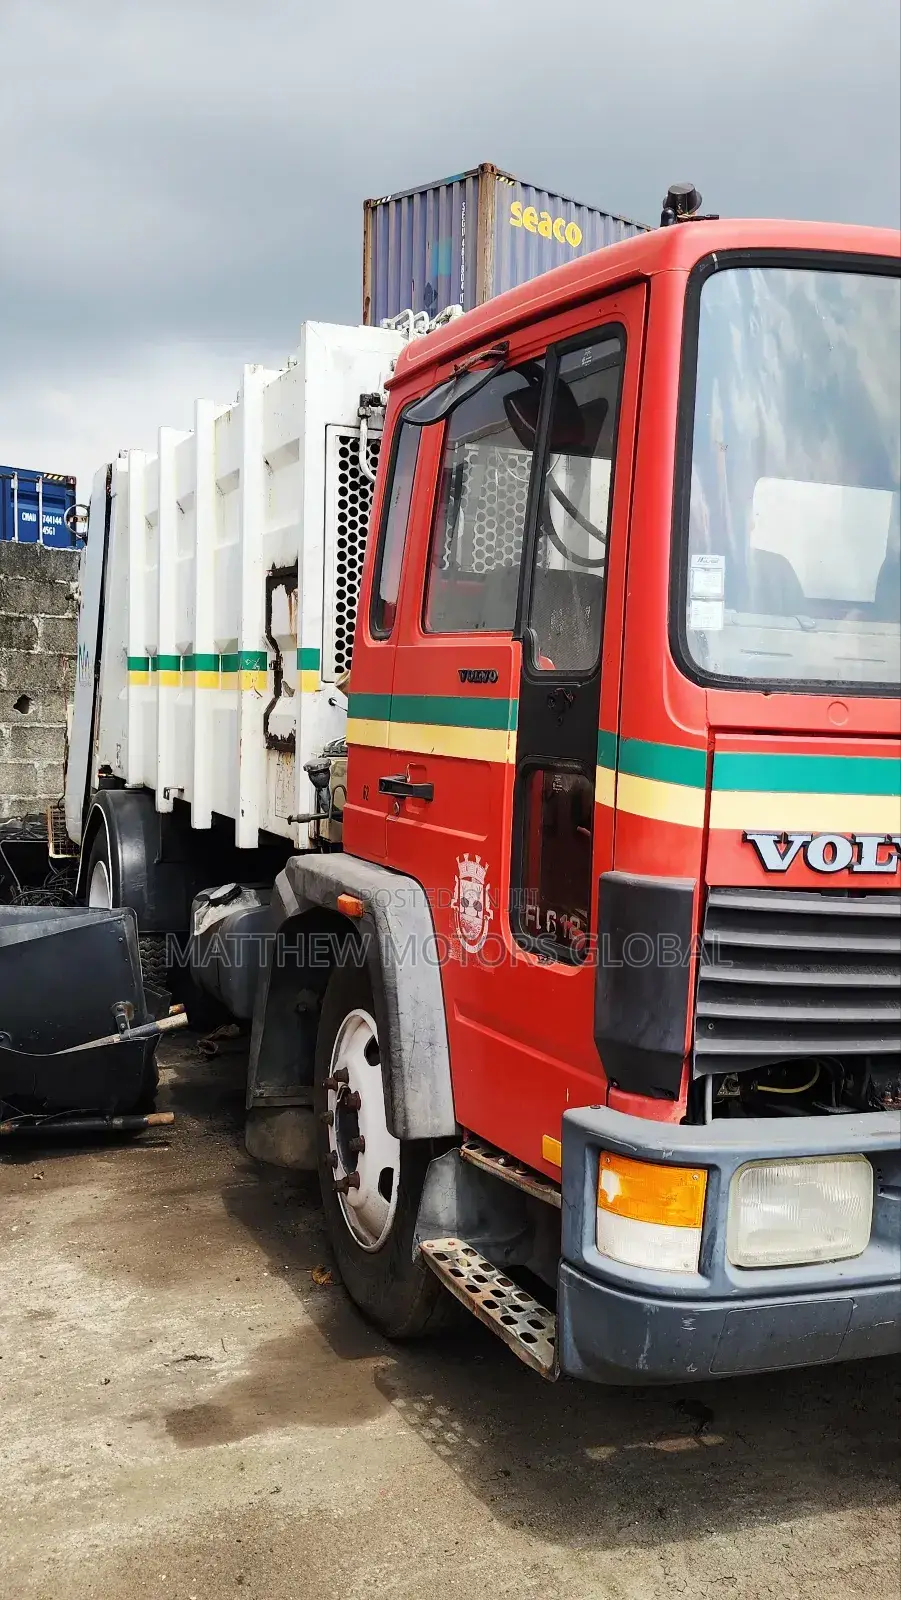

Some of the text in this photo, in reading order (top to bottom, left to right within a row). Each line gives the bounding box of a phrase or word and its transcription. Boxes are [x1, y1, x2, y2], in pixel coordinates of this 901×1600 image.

[509, 201, 583, 248] seaco
[457, 669, 499, 683] VOLVO
[741, 830, 901, 874] VOL
